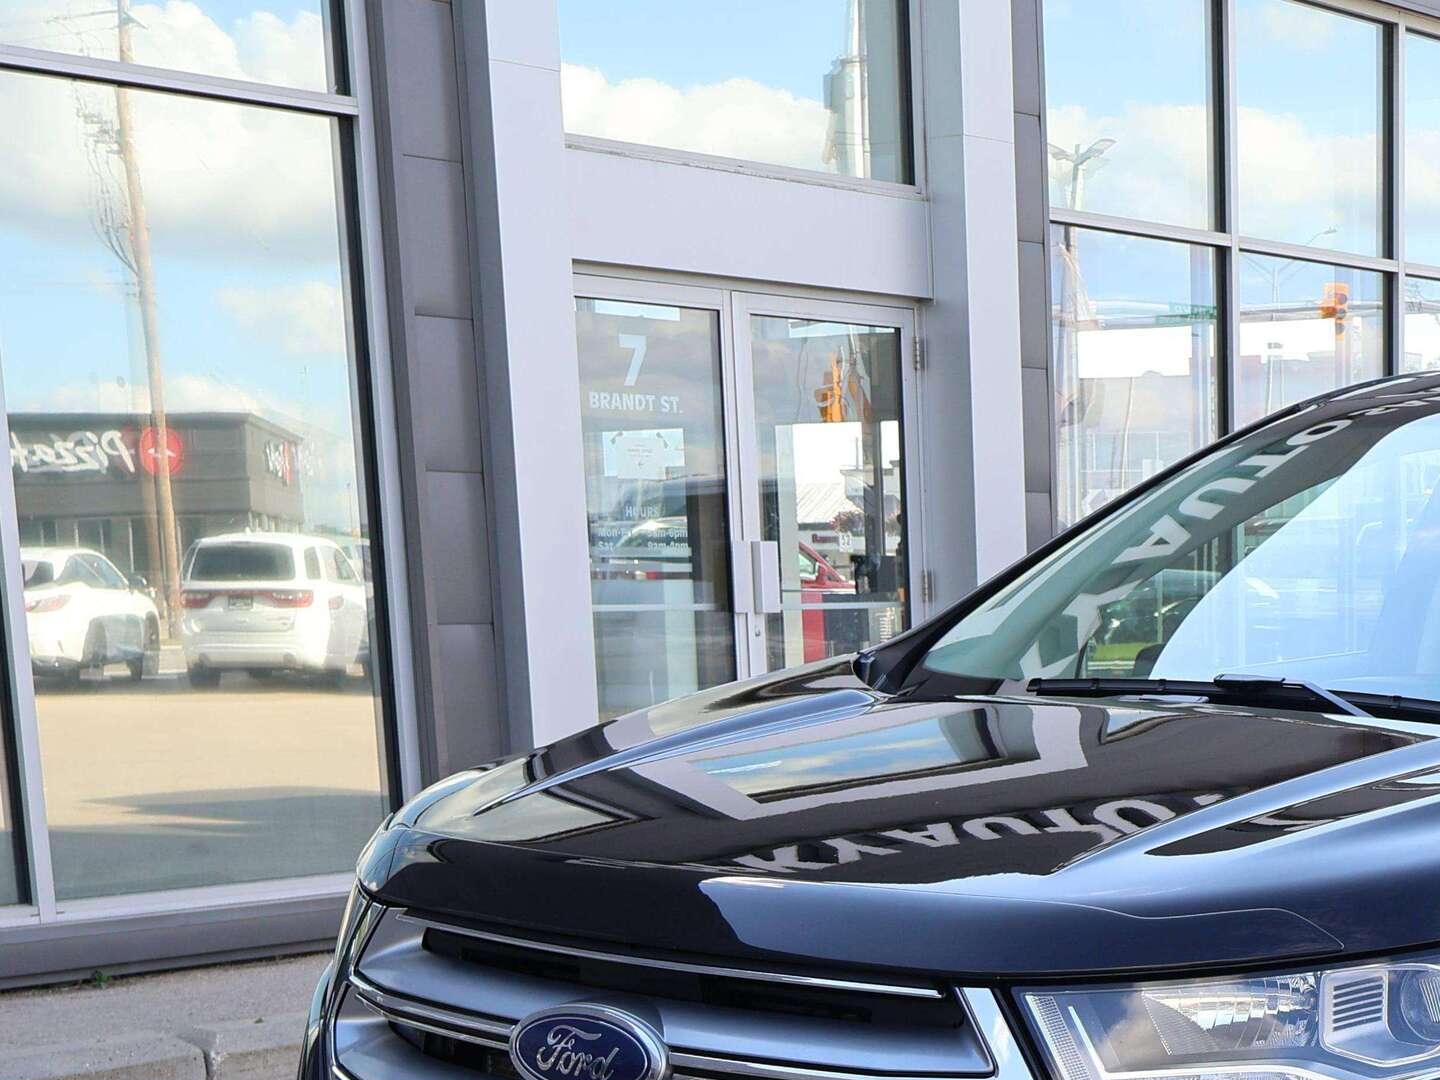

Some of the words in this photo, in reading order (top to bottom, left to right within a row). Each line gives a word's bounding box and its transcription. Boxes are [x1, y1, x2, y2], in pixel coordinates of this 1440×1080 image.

[618, 333, 647, 386] 7
[589, 391, 656, 412] BRANDT
[660, 395, 684, 414] ST.
